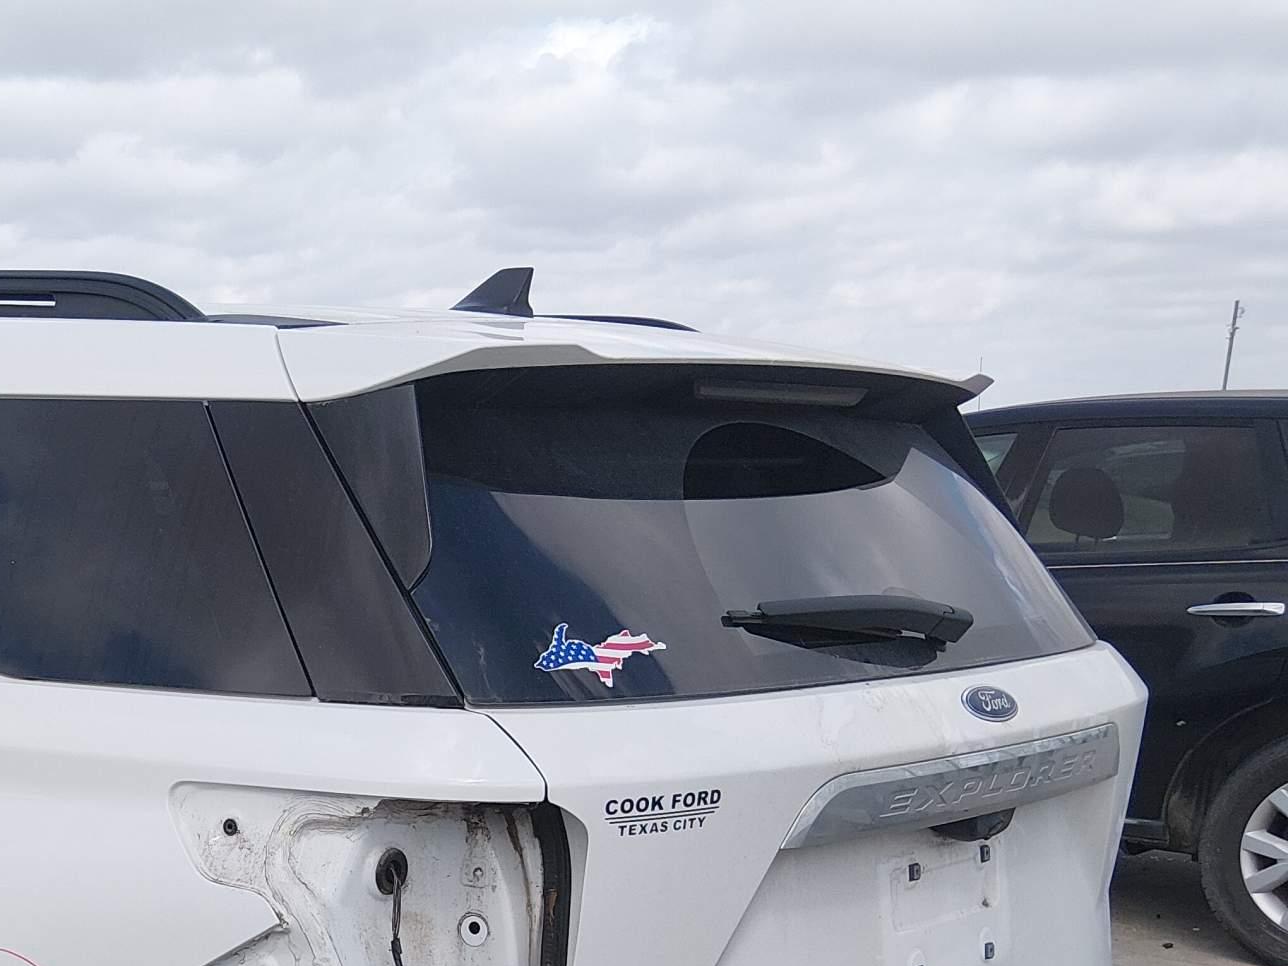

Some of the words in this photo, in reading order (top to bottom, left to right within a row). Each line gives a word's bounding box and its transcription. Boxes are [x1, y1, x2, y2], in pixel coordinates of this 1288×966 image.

[977, 690, 1011, 712] Ford
[880, 750, 1097, 818] EXPLORER
[605, 795, 665, 815] COOK
[671, 789, 722, 810] FORD
[618, 821, 669, 836] TEXAS
[673, 816, 706, 831] CITY
